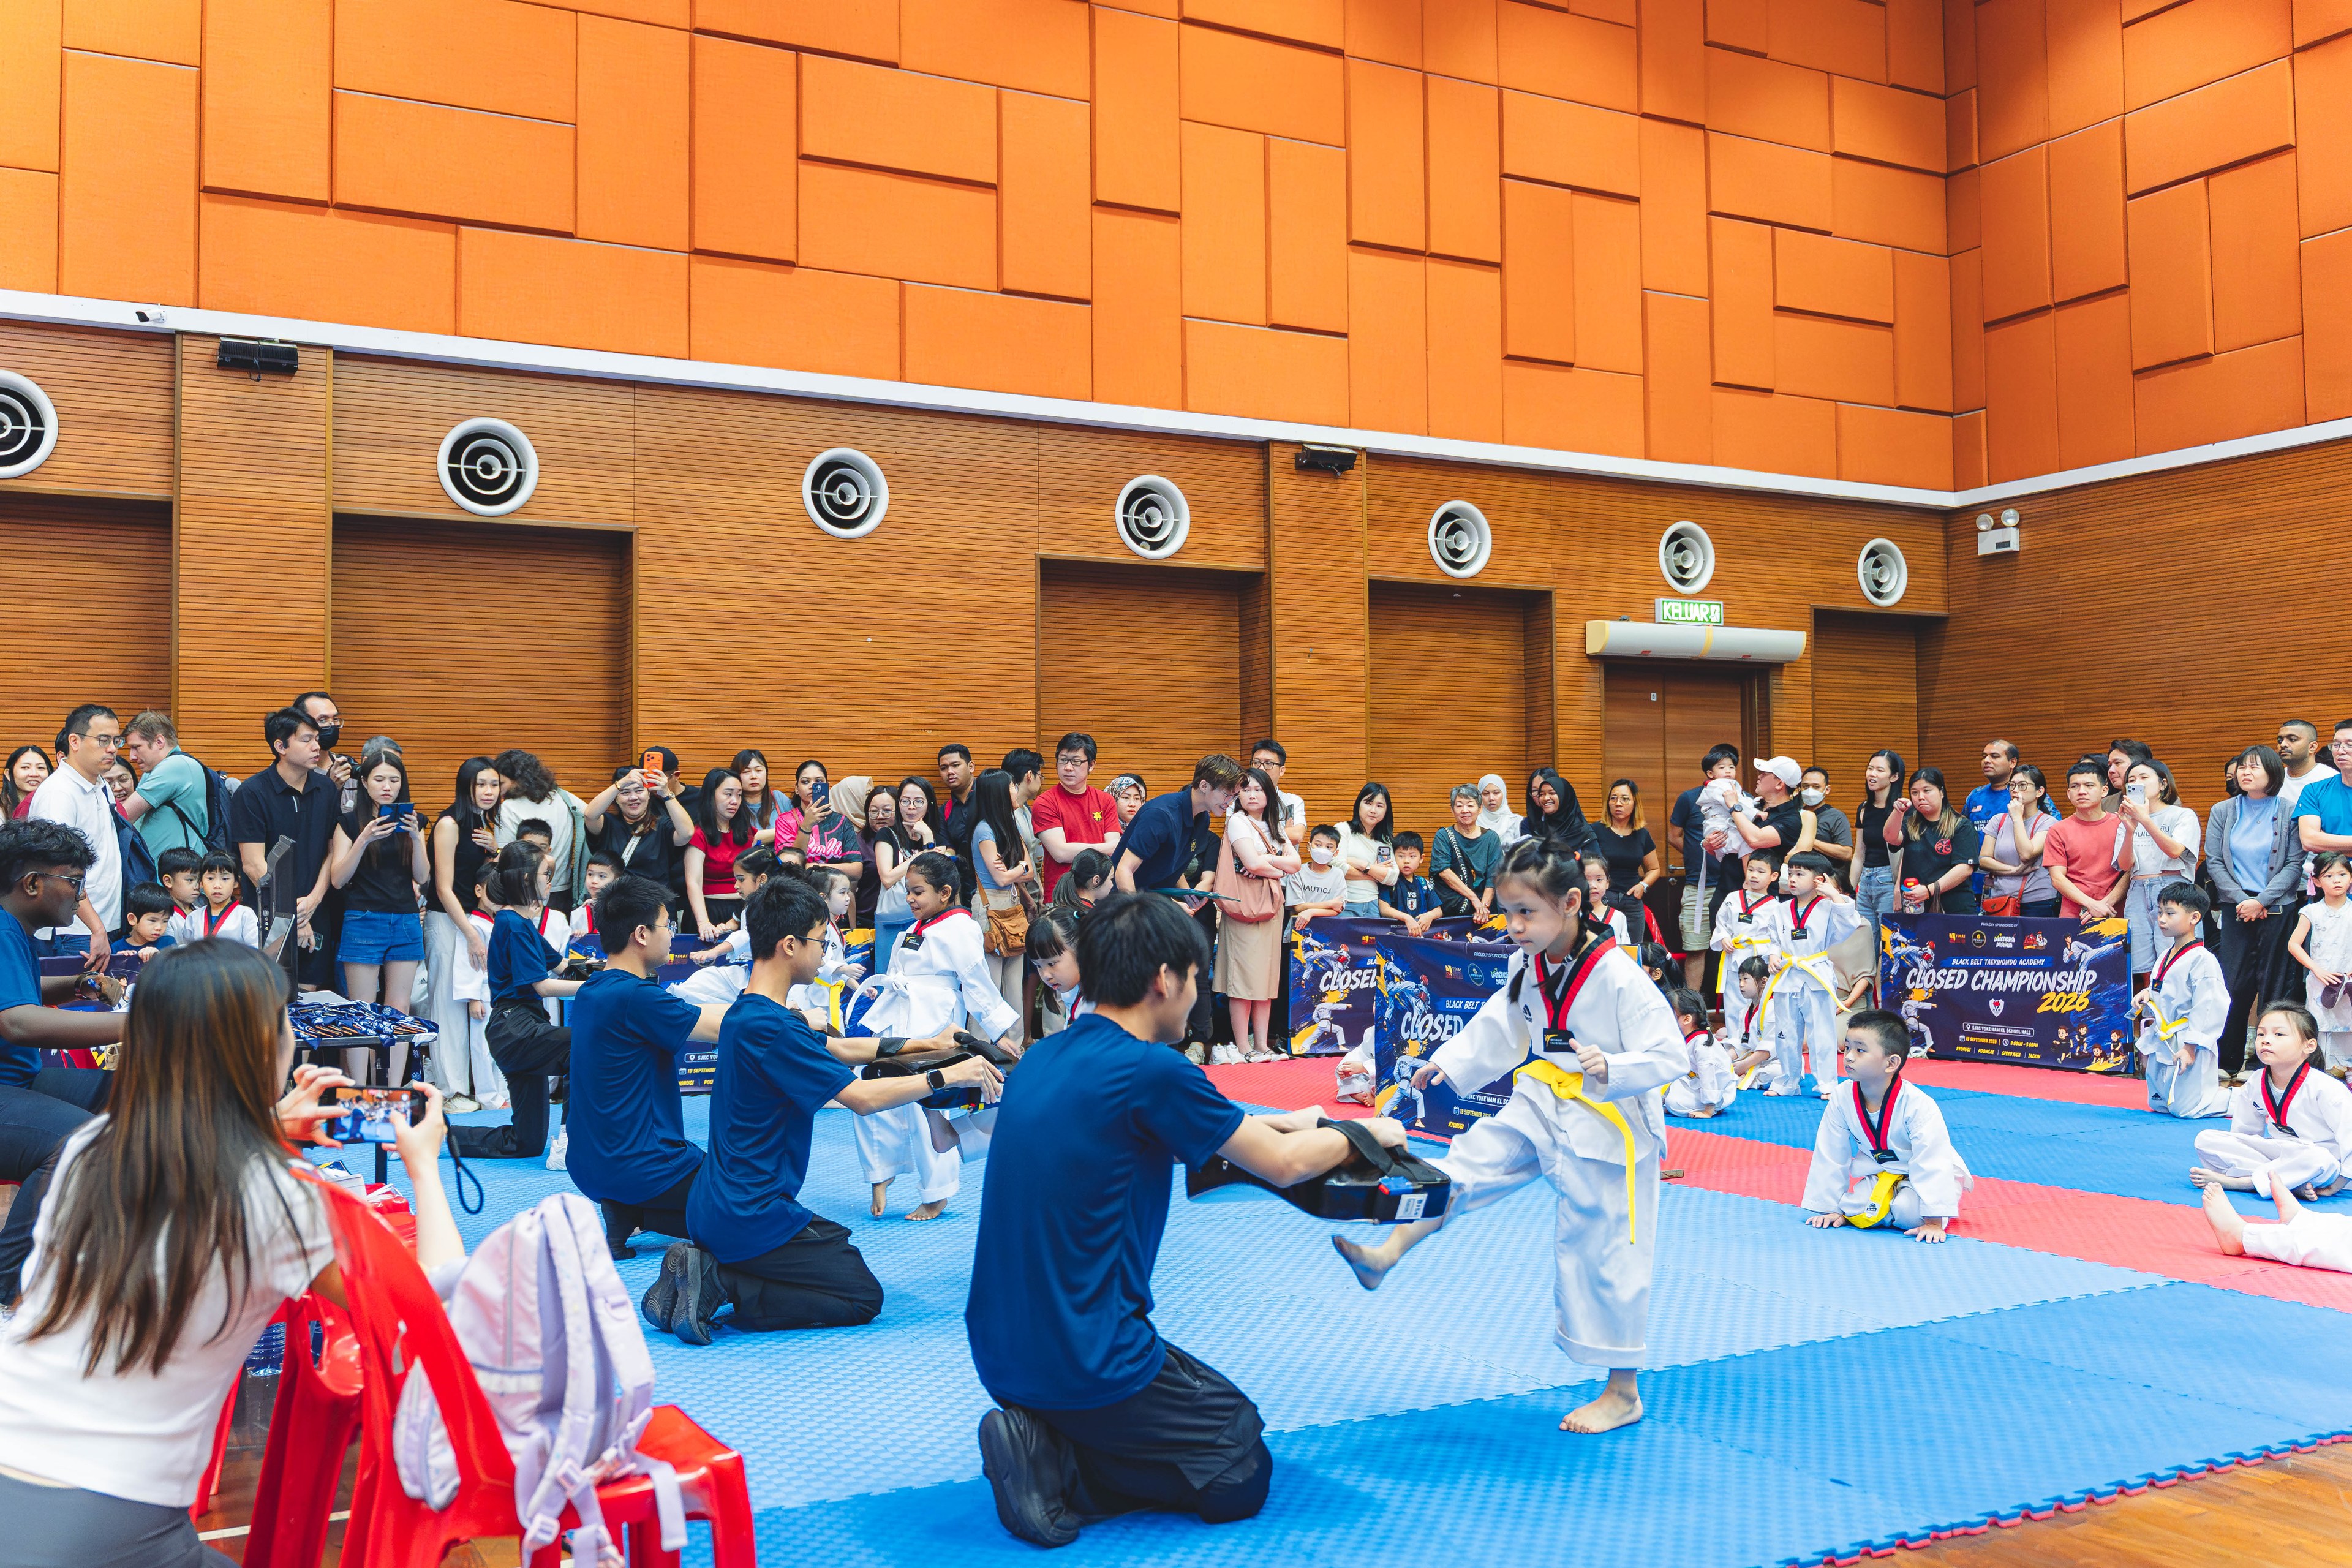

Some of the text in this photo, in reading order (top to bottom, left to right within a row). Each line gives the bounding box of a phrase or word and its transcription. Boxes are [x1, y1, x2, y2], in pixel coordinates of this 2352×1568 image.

[1663, 601, 1709, 622] KELUAR
[1905, 968, 2097, 994] CLOSED CHAMPIONSHIP
[1446, 1000, 1463, 1009] BLACK
[1463, 1001, 1480, 1010] BELT
[2037, 990, 2092, 1014] 2026
[1401, 1011, 1464, 1042] CLOSED
